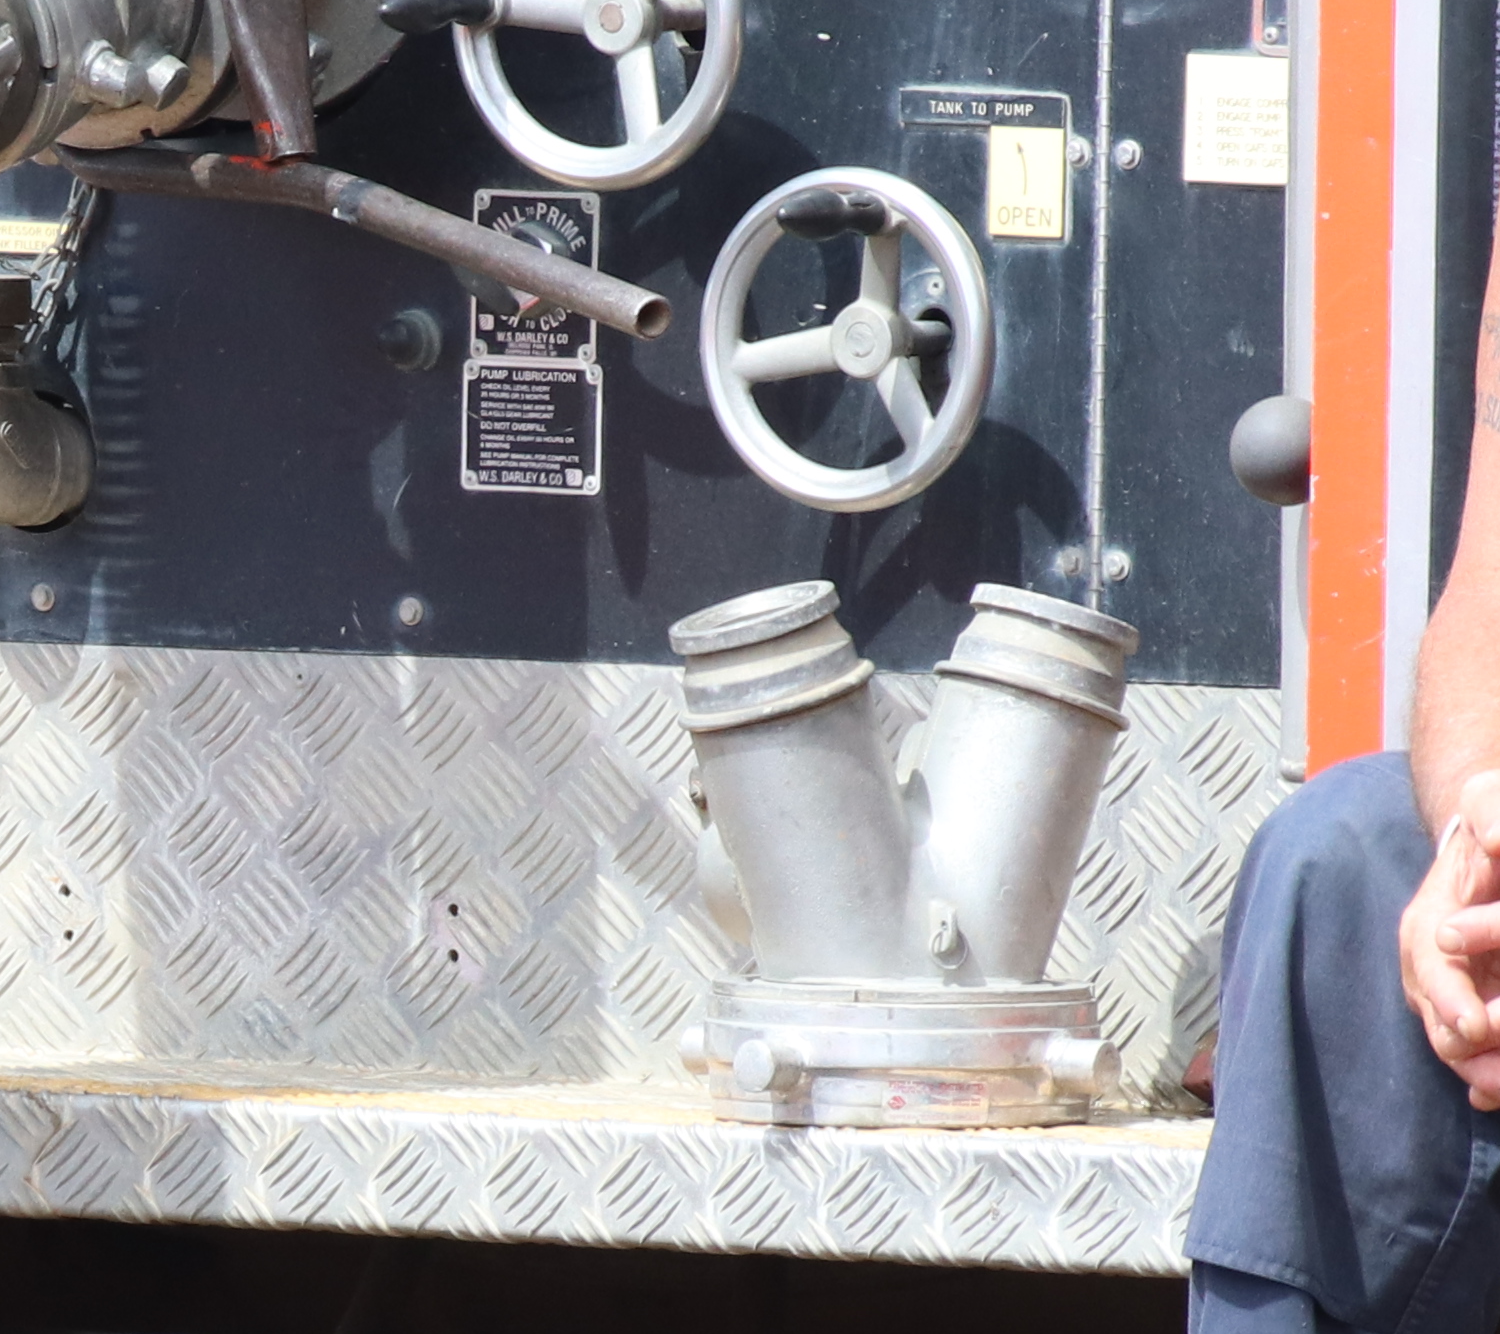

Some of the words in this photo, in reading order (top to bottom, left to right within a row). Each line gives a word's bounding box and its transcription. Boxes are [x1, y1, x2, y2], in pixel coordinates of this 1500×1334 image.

[928, 100, 965, 116] TANK
[970, 101, 988, 116] TO
[994, 101, 1034, 118] PUMP
[998, 206, 1053, 228] OPEN
[535, 202, 587, 253] PRIME
[11, 240, 49, 252] FILLER
[514, 331, 548, 344] DARLEY
[556, 333, 569, 345] CO
[480, 368, 509, 380] PUMP
[512, 370, 577, 383] LUBRICATION
[480, 421, 493, 430] DO
[493, 421, 511, 431] NOT
[511, 422, 547, 432] OVERFILL
[501, 471, 538, 484] DARLEY
[538, 472, 548, 484] &
[548, 473, 563, 485] CO
